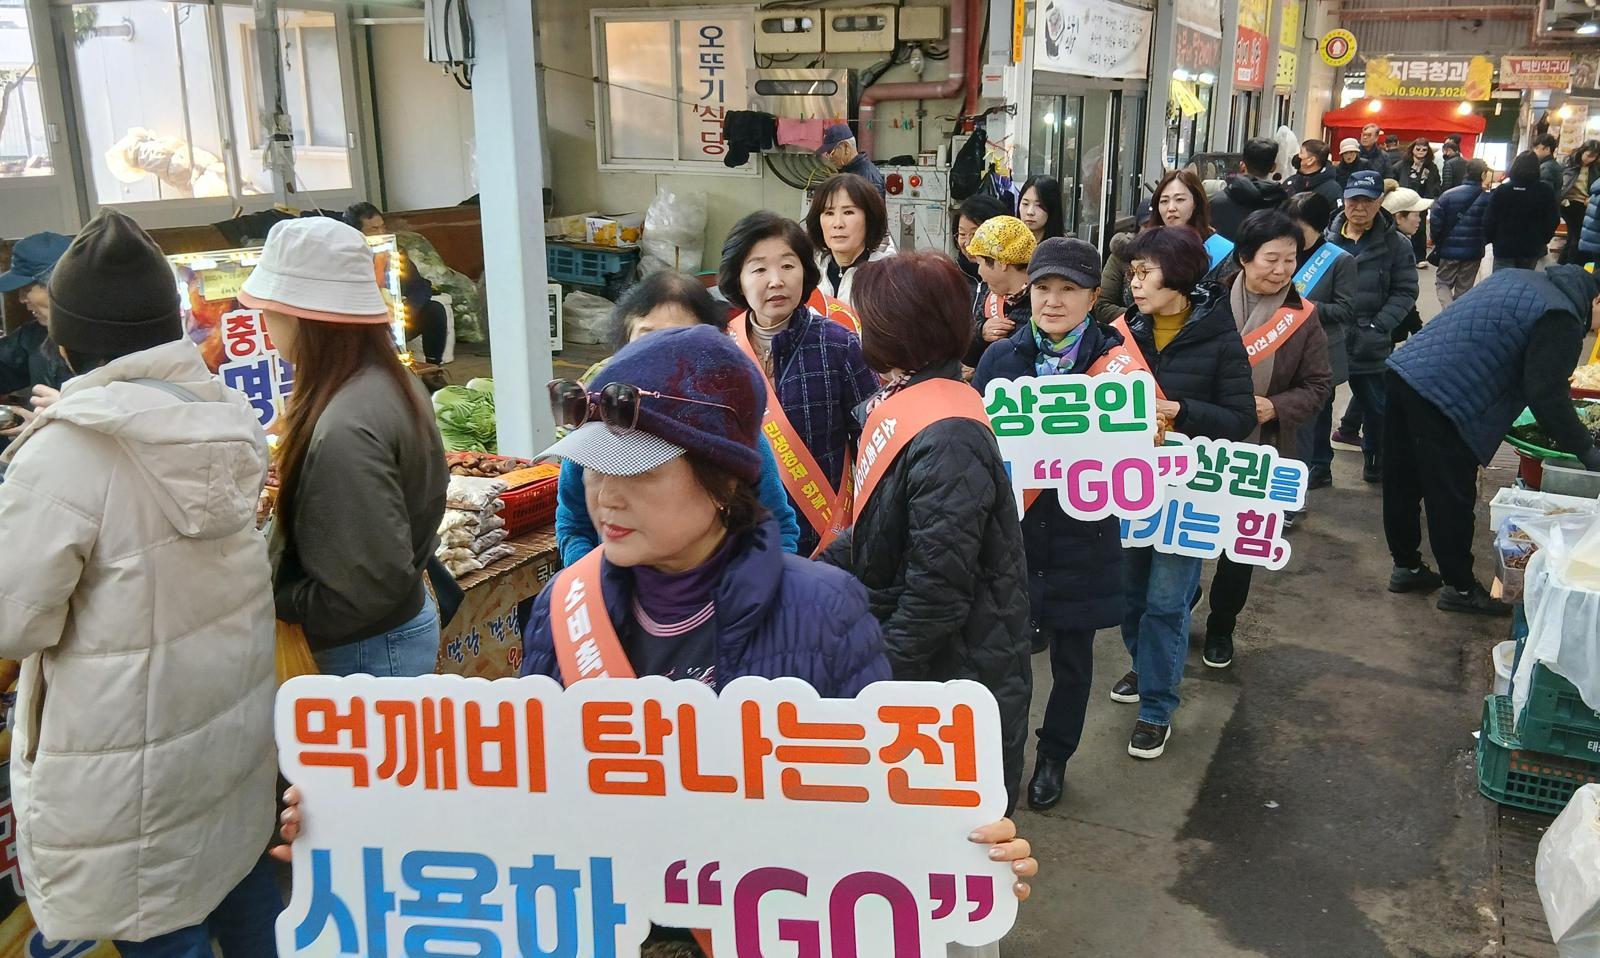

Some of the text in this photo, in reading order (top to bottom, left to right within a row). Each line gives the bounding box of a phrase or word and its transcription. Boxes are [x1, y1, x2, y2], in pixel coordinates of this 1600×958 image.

[1388, 60, 1470, 82] 지욱청과
[1234, 509, 1284, 563] 힘,
[295, 695, 983, 808] 먹깨비 탐나는전
[295, 846, 626, 958] 사용하
